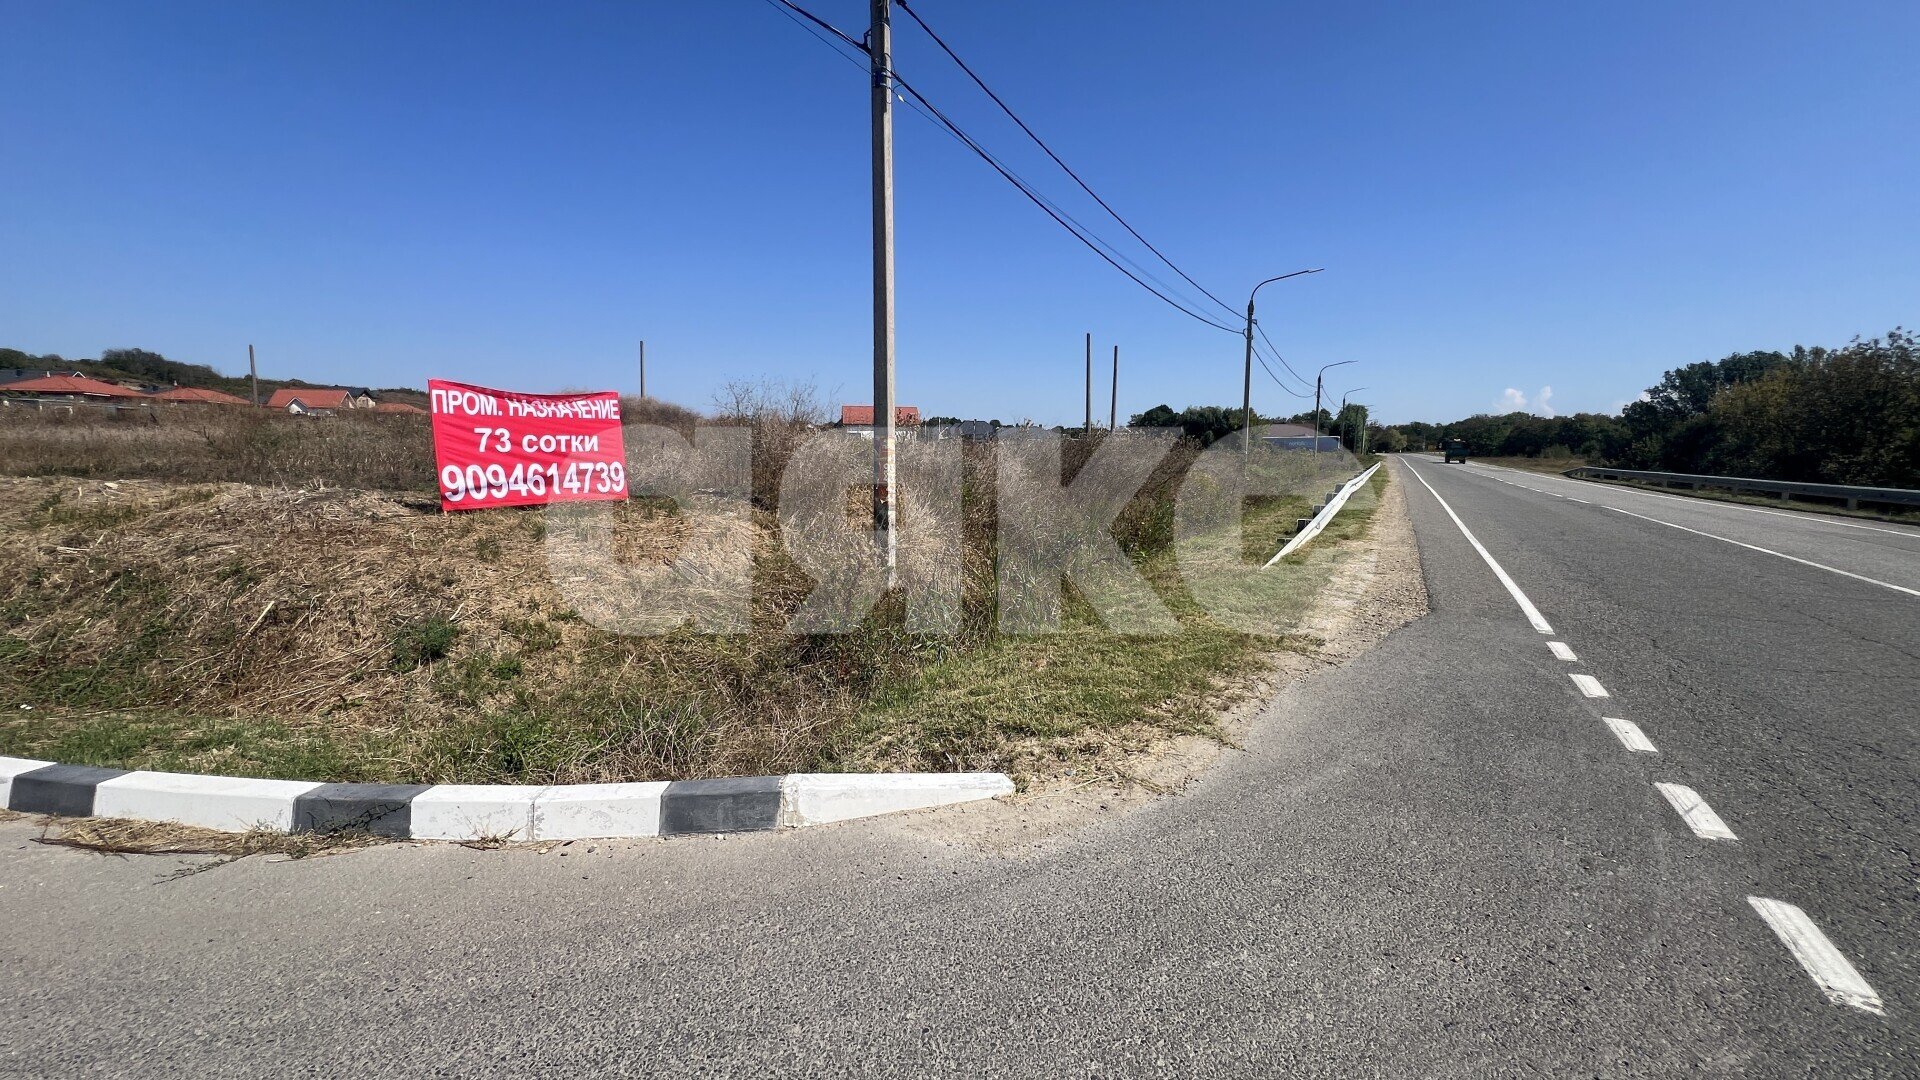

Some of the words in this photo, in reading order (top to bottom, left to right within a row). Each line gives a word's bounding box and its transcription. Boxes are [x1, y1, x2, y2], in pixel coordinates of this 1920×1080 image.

[431, 389, 503, 416] ПРОМ.
[506, 399, 621, 420] НАЗНАЧЕНИЕ
[474, 427, 512, 453] 73
[521, 434, 599, 453] сотки
[441, 461, 625, 502] 9094614739
